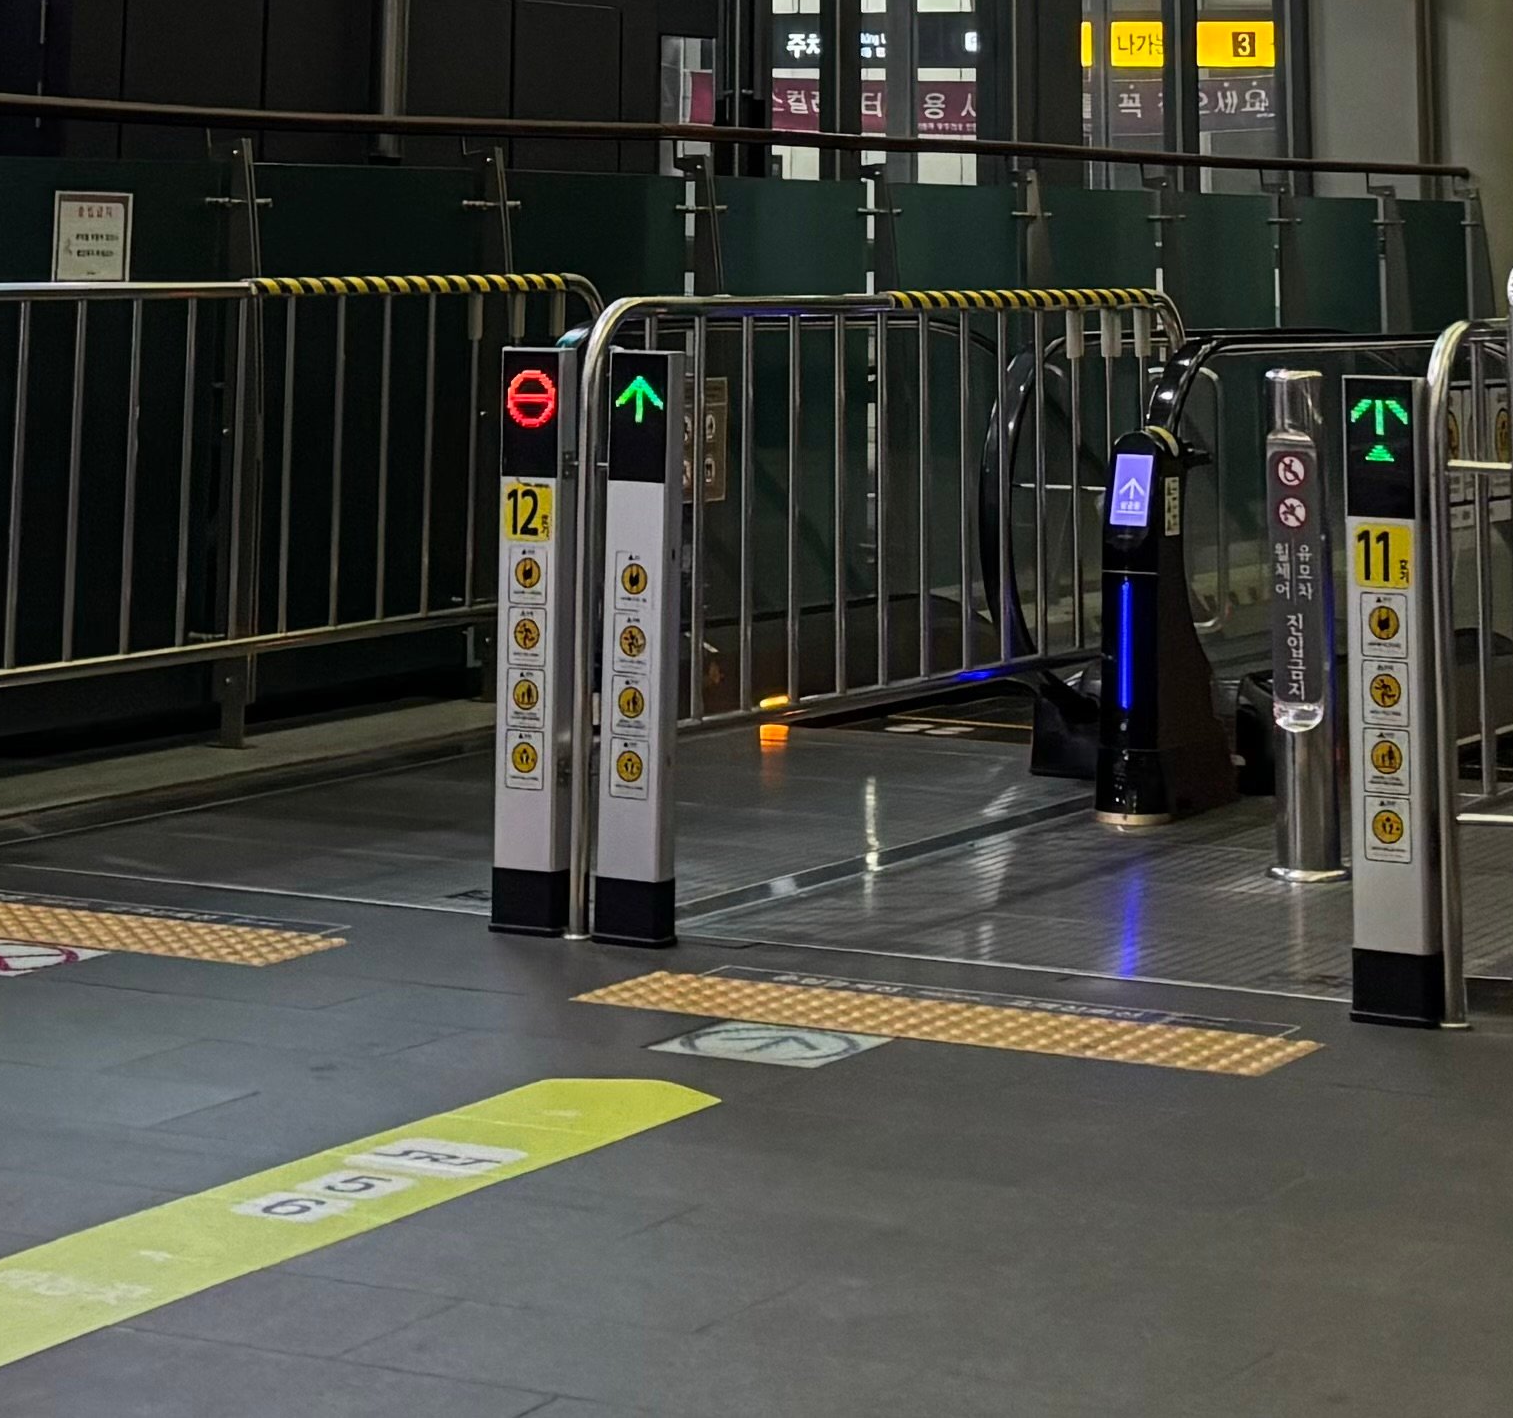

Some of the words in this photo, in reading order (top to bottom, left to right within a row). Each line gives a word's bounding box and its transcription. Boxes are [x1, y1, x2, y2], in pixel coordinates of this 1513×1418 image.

[1237, 33, 1251, 56] 3
[508, 488, 539, 536] 12
[1296, 544, 1312, 601] 유모차
[1357, 529, 1390, 582] 11
[1287, 613, 1306, 701] 진입금지
[261, 1197, 326, 1217] 6
[326, 1174, 392, 1194] 5
